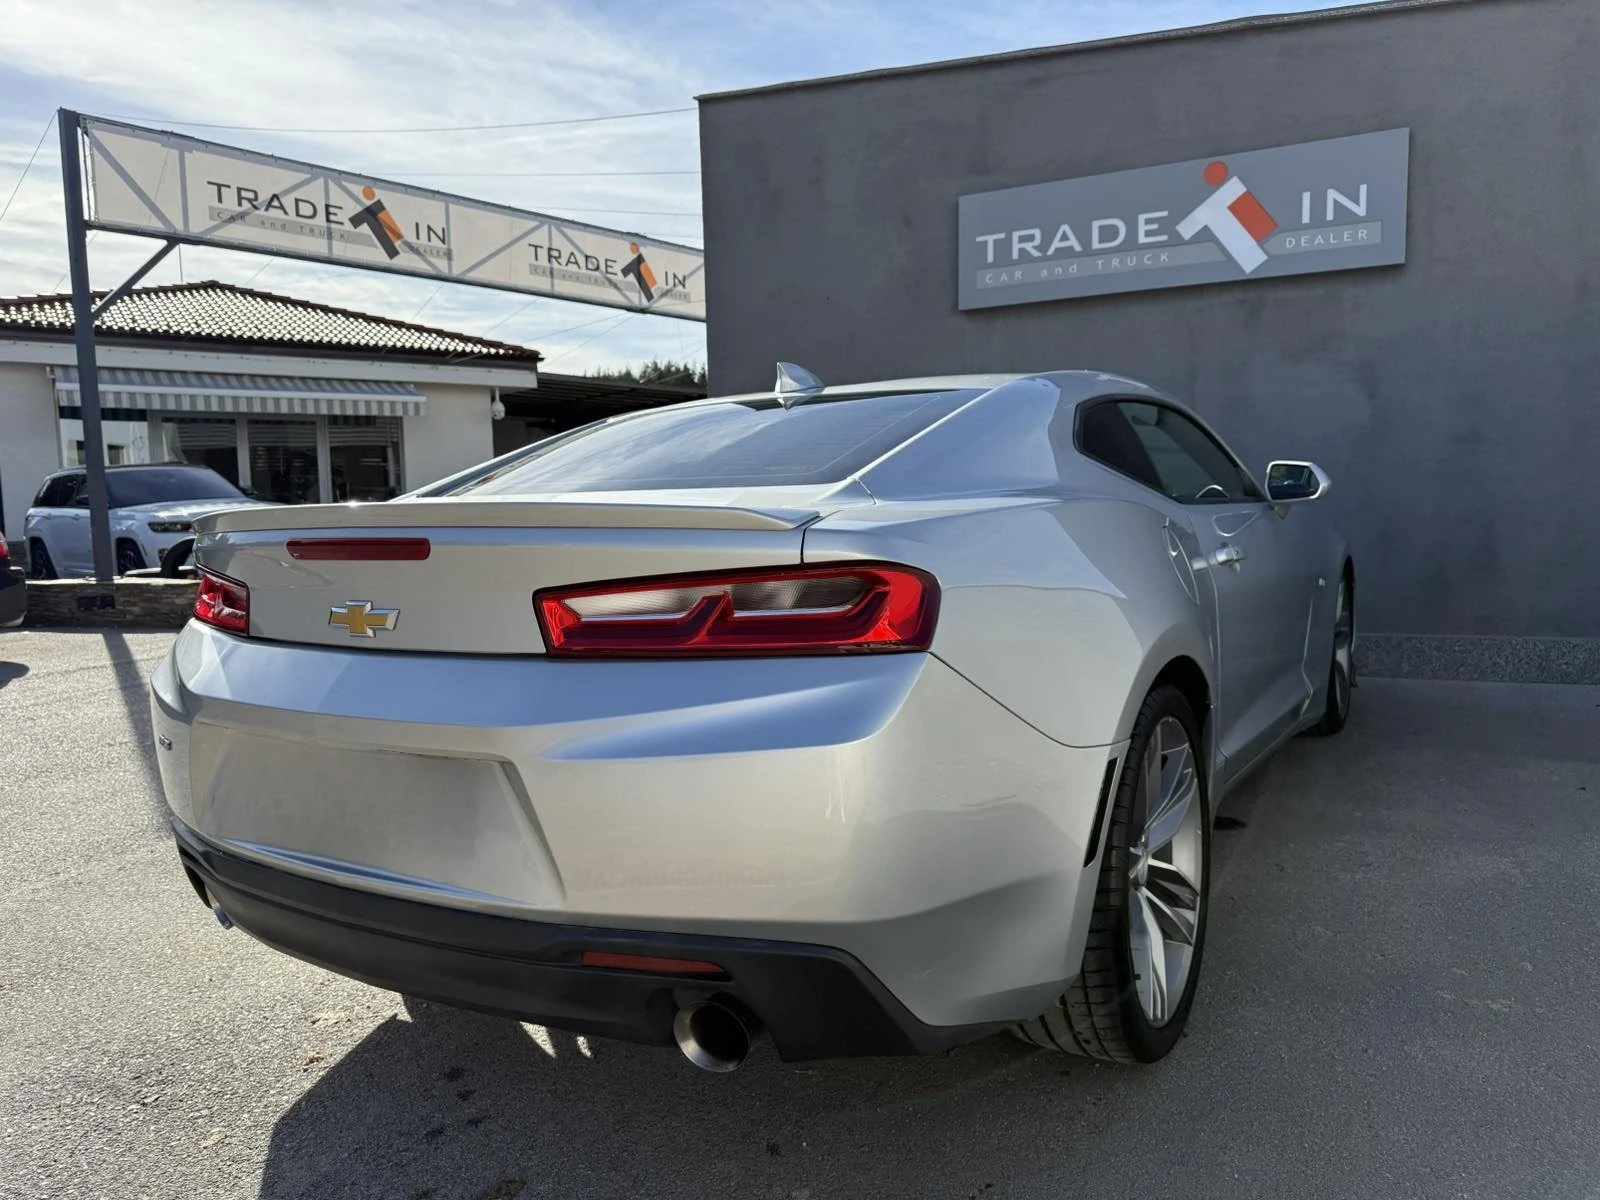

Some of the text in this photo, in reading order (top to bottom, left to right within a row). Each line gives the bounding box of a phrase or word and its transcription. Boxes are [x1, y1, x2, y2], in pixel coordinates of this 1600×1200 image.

[206, 180, 344, 226] TRADE
[415, 221, 446, 246] IN
[975, 210, 1169, 264] TRADE
[1301, 183, 1368, 225] IN
[528, 243, 619, 276] TRADE
[664, 270, 687, 290] IN
[985, 228, 1369, 284] CAR and TRUCK DEALER
